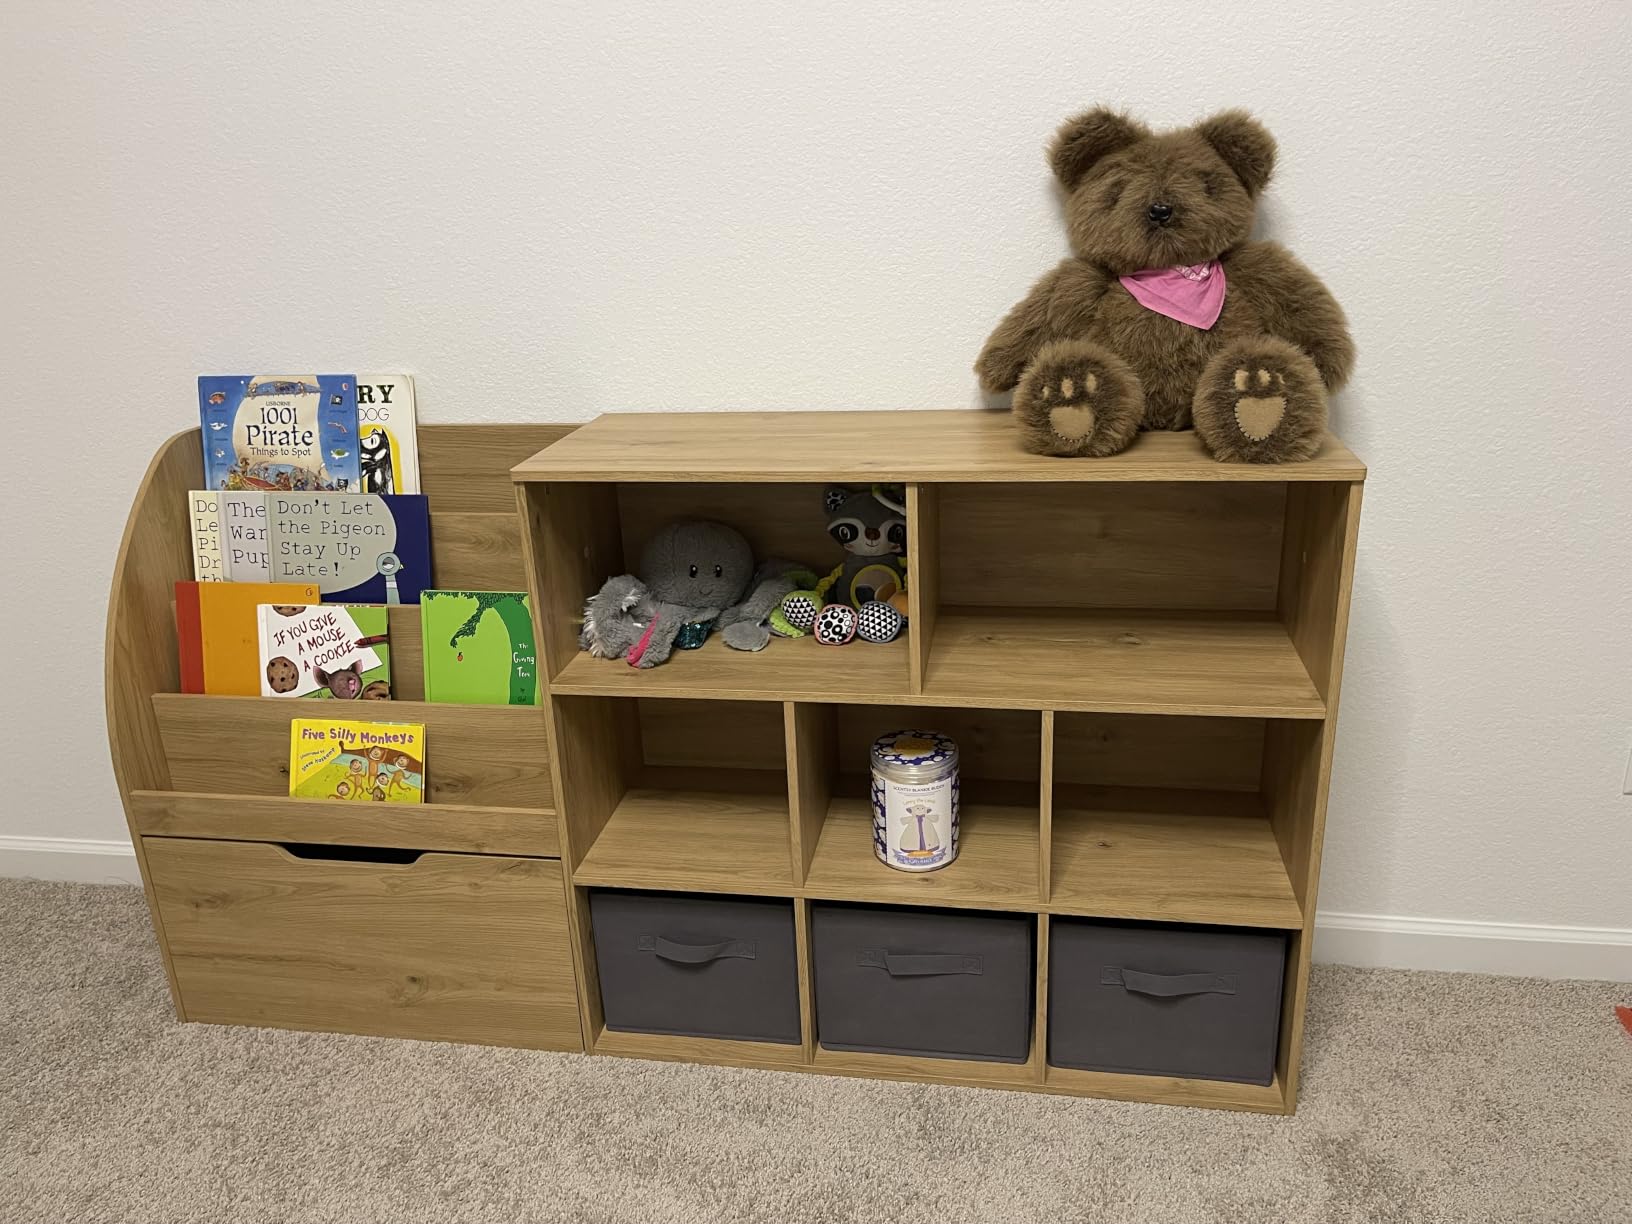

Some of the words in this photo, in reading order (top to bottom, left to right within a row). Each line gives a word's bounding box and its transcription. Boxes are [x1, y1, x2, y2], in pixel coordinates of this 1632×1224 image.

[260, 407, 298, 425] 1001
[358, 407, 390, 421] DOG
[246, 424, 314, 446] Pirate
[250, 447, 279, 458] Things
[280, 447, 290, 456] to
[292, 447, 312, 458] Spot
[227, 502, 267, 518] The
[277, 499, 330, 515] Don't
[340, 501, 374, 516] Let
[196, 518, 219, 533] Le
[278, 520, 311, 534] the
[320, 520, 386, 539] Pigeon
[198, 536, 219, 551] Pi
[280, 541, 326, 560] Stay
[336, 542, 361, 560] Up
[282, 561, 339, 576] Late!
[273, 630, 286, 647] IF
[287, 620, 308, 640] YOU
[309, 612, 337, 632] GIVE
[298, 642, 305, 655] A
[306, 627, 346, 651] MOUSE
[303, 659, 311, 672] A
[314, 639, 355, 667] COOKIE
[301, 728, 325, 740] Five
[329, 727, 357, 744] Silly
[360, 732, 415, 745] Monkeys
